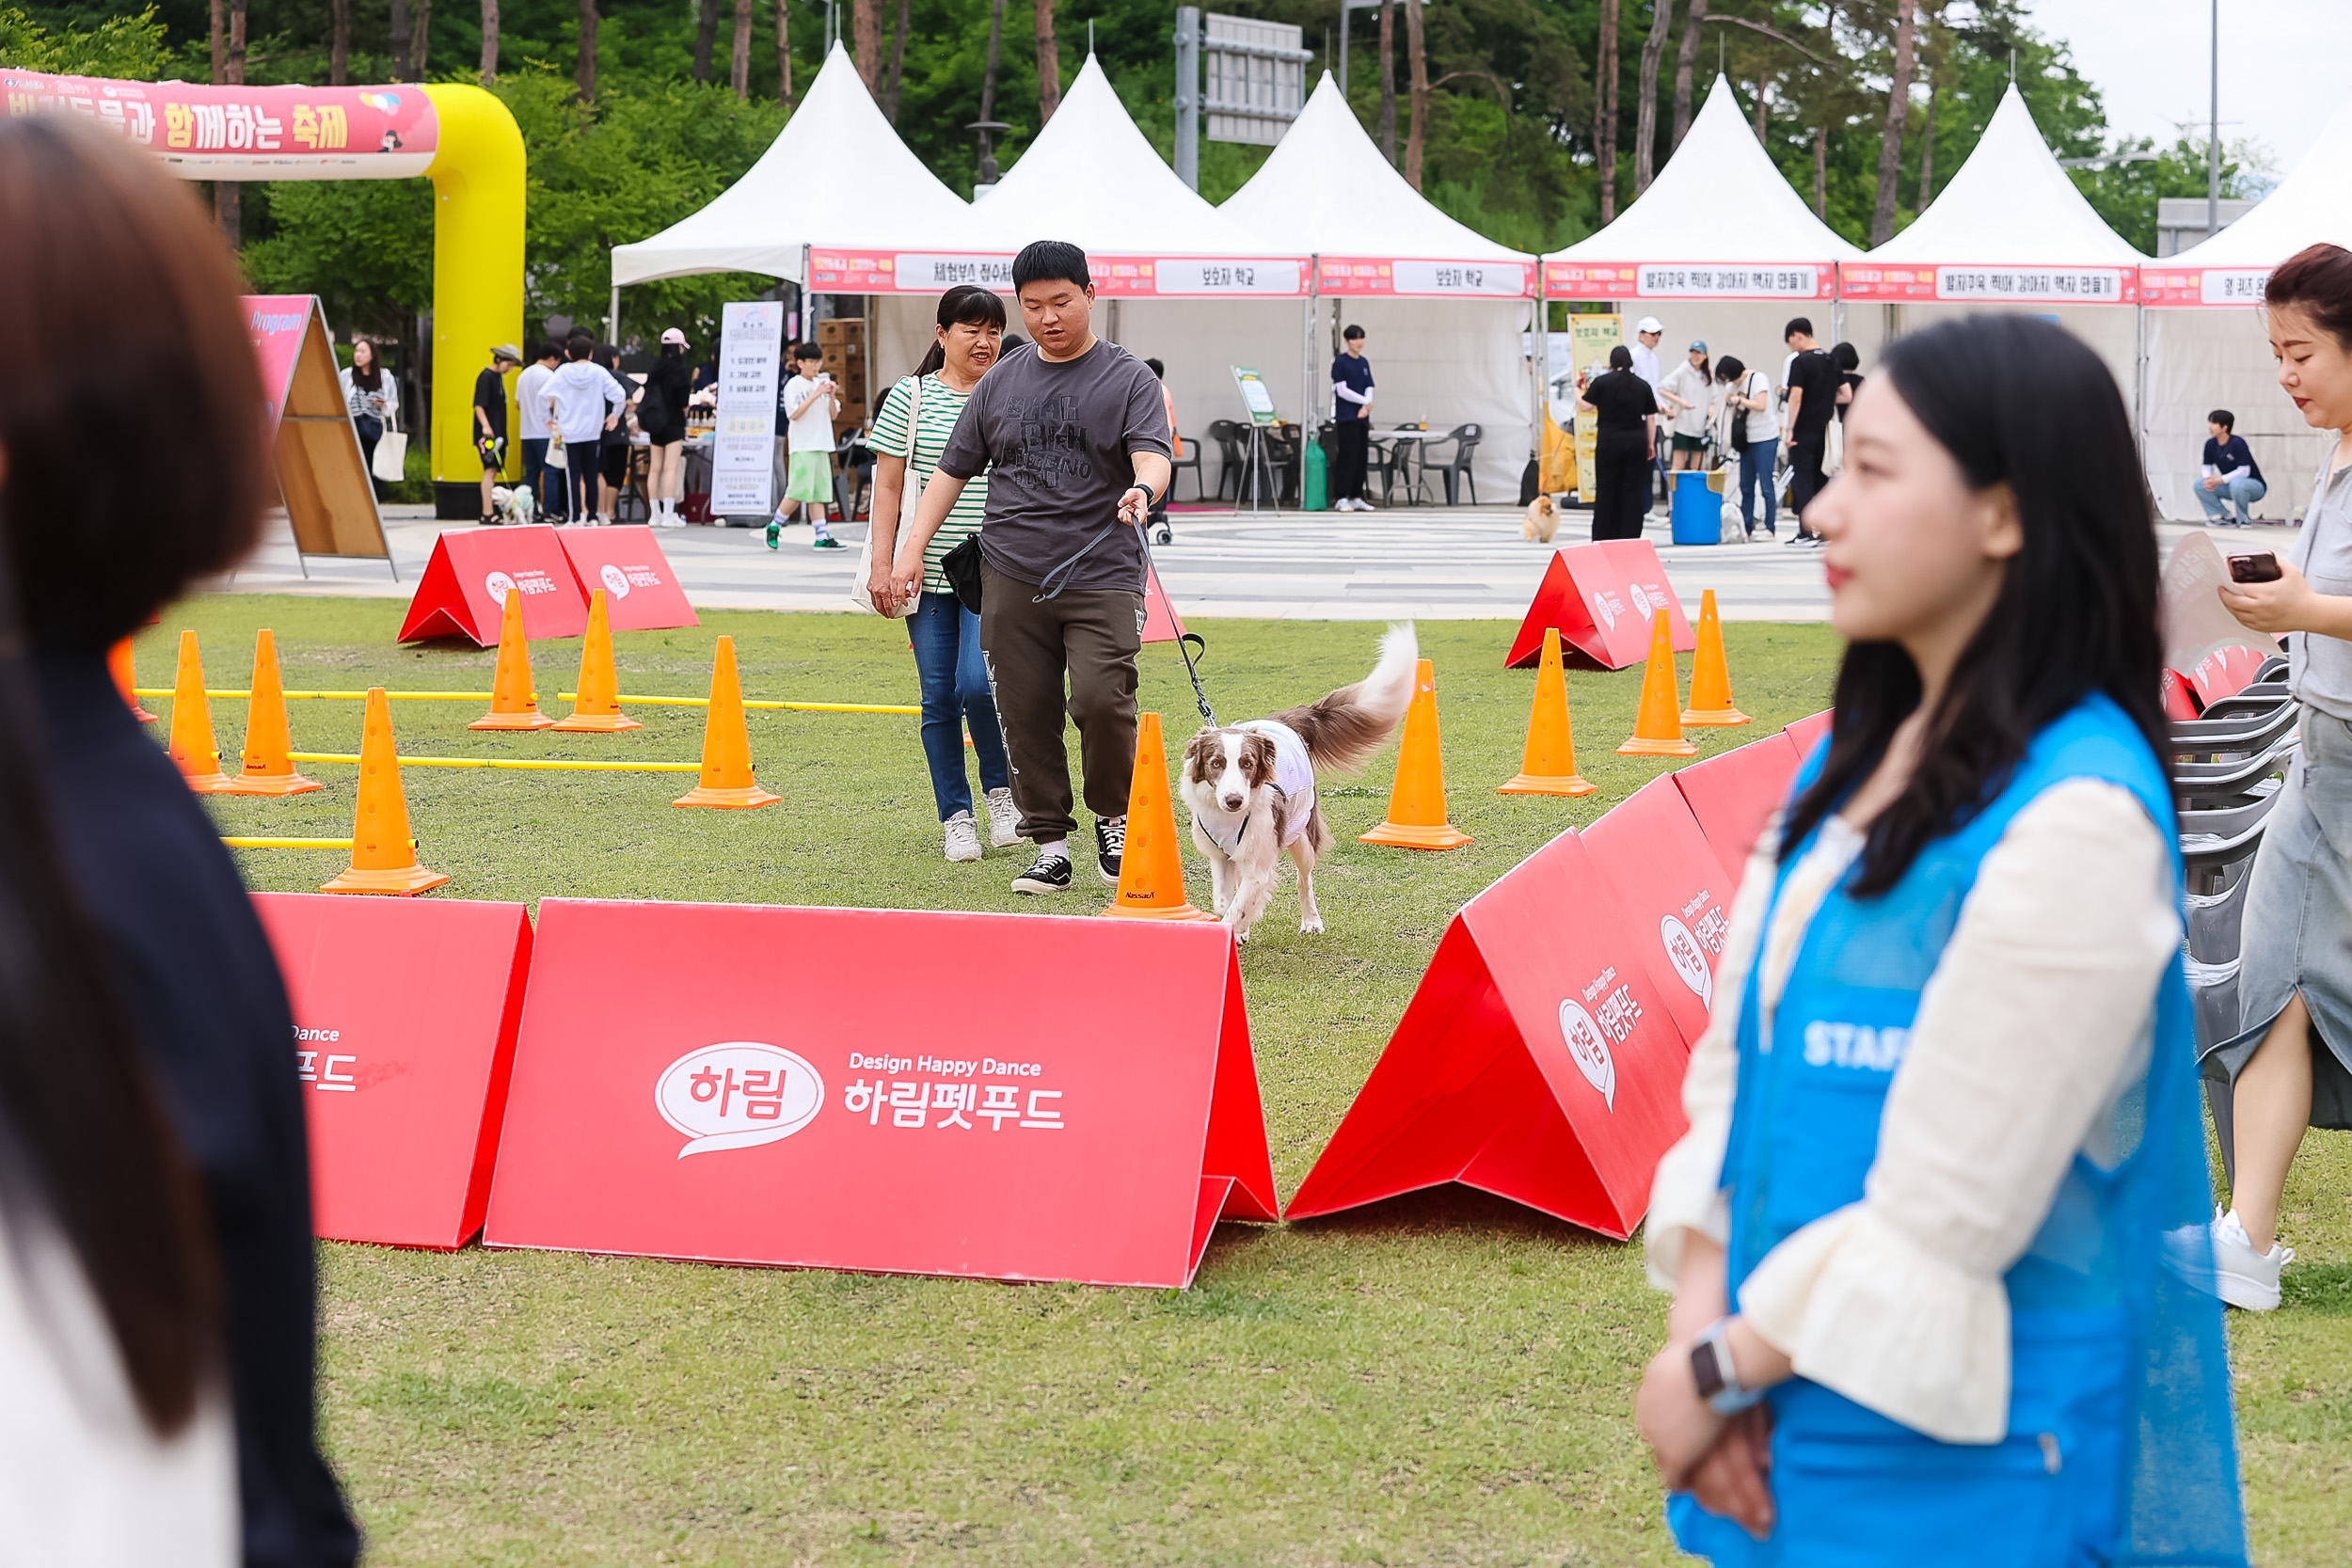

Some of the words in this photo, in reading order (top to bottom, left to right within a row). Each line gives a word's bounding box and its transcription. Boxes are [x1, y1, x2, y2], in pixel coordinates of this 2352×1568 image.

[164, 103, 283, 150] 함께하는
[292, 103, 348, 150] 축제
[934, 262, 976, 282] 체험부스
[1202, 267, 1232, 286] 보호자
[1235, 267, 1255, 286] 학교
[1436, 269, 1461, 287] 보호자
[1466, 269, 1484, 287] 학교
[1716, 272, 1747, 290] 강아지
[1752, 272, 1773, 290] 액자
[1777, 272, 1807, 290] 만들기
[2018, 276, 2049, 293] 강아지
[2054, 276, 2075, 293] 액자
[2080, 277, 2111, 293] 만들기
[251, 310, 302, 336] Program
[1669, 930, 1703, 976] 하림
[1595, 983, 1644, 1045] 하림펫푸드
[1568, 1016, 1605, 1070] 하림
[849, 1052, 913, 1075] Design
[916, 1054, 978, 1078] Happy
[981, 1057, 1042, 1078] Dance
[690, 1065, 787, 1121] 하림
[844, 1079, 1065, 1132] 하림펫푸드
